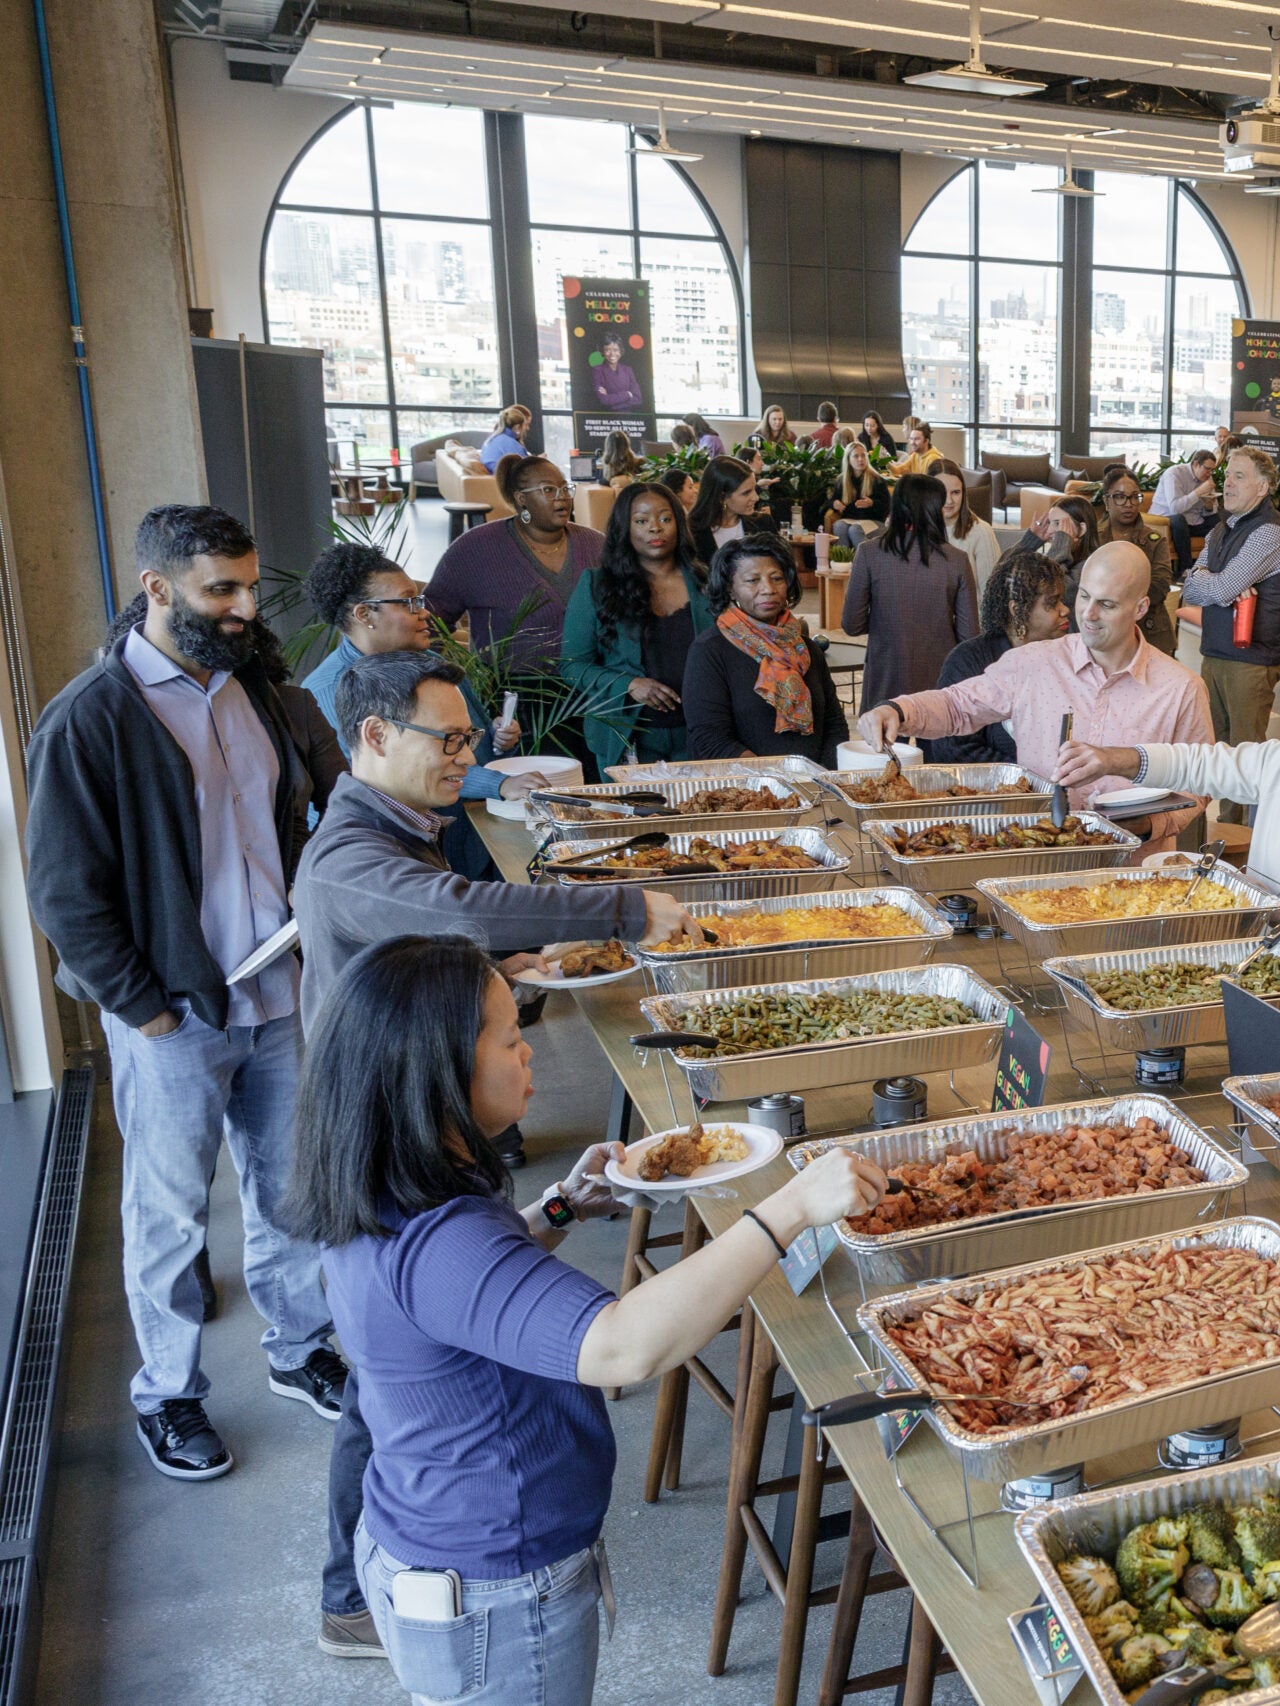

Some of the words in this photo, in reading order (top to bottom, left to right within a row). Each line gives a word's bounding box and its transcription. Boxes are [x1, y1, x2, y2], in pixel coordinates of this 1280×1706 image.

[585, 300, 630, 311] MELLODY
[588, 313, 630, 323] HOBSON
[1248, 349, 1280, 359] JOHNSON
